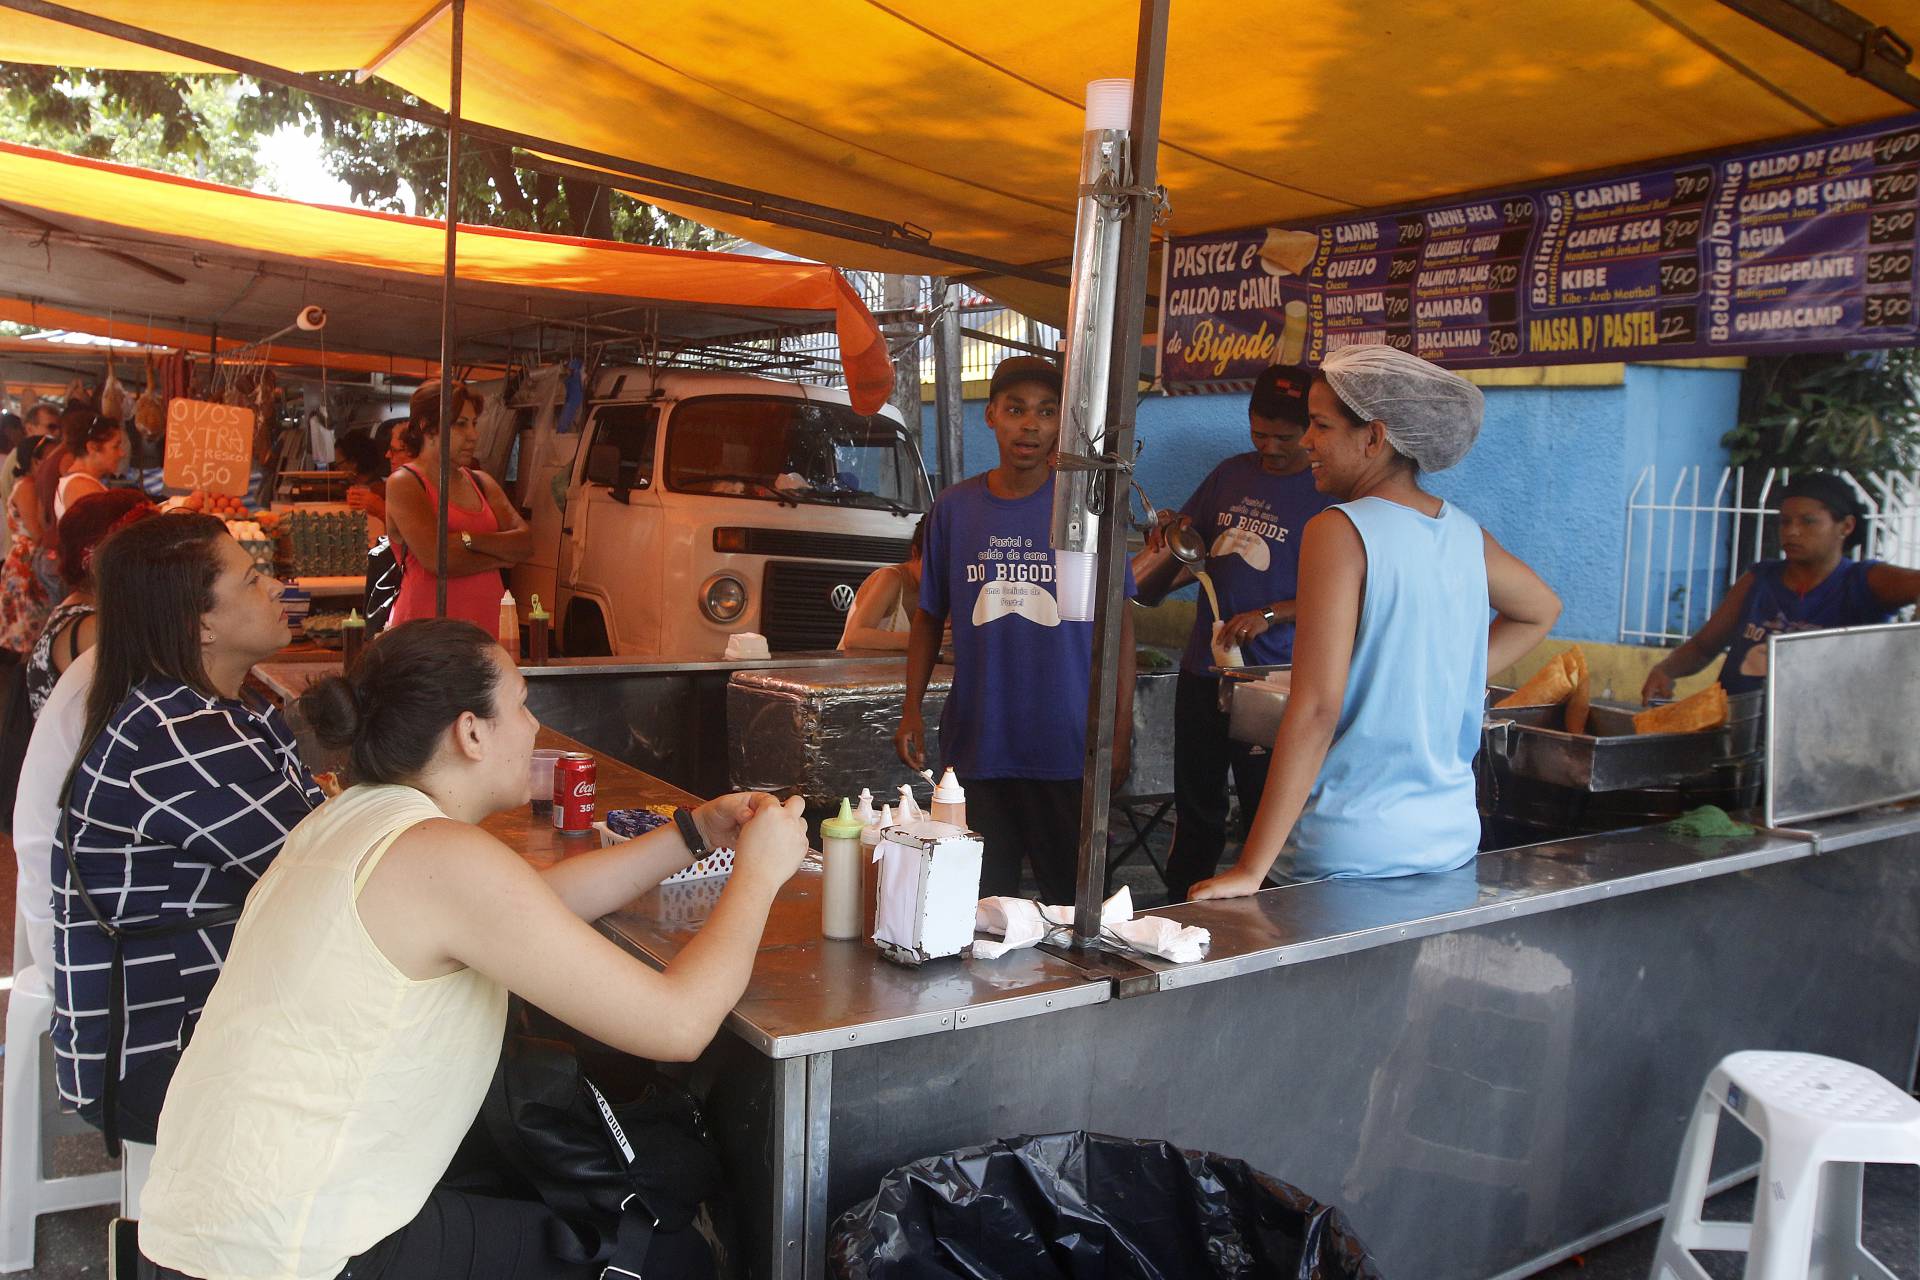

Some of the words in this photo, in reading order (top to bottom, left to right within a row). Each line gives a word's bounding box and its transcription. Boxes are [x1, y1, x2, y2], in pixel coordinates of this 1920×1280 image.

[1748, 154, 1799, 179] CALDO
[1803, 149, 1827, 169] DE
[1828, 140, 1874, 164] CANA
[1574, 181, 1641, 209] CARNE
[1738, 189, 1792, 213] CALDO
[1795, 185, 1818, 206] DE
[1822, 178, 1872, 202] CANA
[1427, 208, 1466, 228] CARNE
[1466, 204, 1497, 223] SECA
[1336, 222, 1379, 243] CARNE
[1567, 224, 1619, 248] CARNE
[1620, 218, 1661, 241] SECA
[1173, 241, 1238, 278] PASTEL
[1241, 244, 1258, 269] e
[1312, 228, 1333, 277] Pasta
[1532, 194, 1562, 304] Bolinhos
[1327, 257, 1377, 279] QUEIJO
[1561, 267, 1607, 290] KIBE
[1737, 256, 1854, 286] REFRIGERANTE
[1170, 286, 1220, 317] CALDO
[1221, 289, 1237, 311] DE
[1239, 276, 1282, 310] CANA
[1416, 296, 1482, 319] CAMARÃO
[1530, 317, 1579, 353] MASSA
[1582, 315, 1600, 353] P/
[1603, 311, 1658, 348] PASTEL
[1735, 306, 1843, 332] GUARACAMP
[1184, 319, 1275, 376] Bigode
[1417, 329, 1481, 349] BACALHAU
[172, 400, 240, 424] OVOS
[168, 422, 244, 453] EXTRA
[989, 535, 1021, 548] Pastel
[1025, 538, 1033, 548] e
[1217, 512, 1232, 526] DO
[1236, 516, 1289, 543] BIGODE
[978, 549, 1004, 560] caldo
[1006, 549, 1020, 560] de
[1024, 552, 1048, 561] cana
[966, 563, 985, 582] DO
[995, 563, 1056, 582] BIGOD
